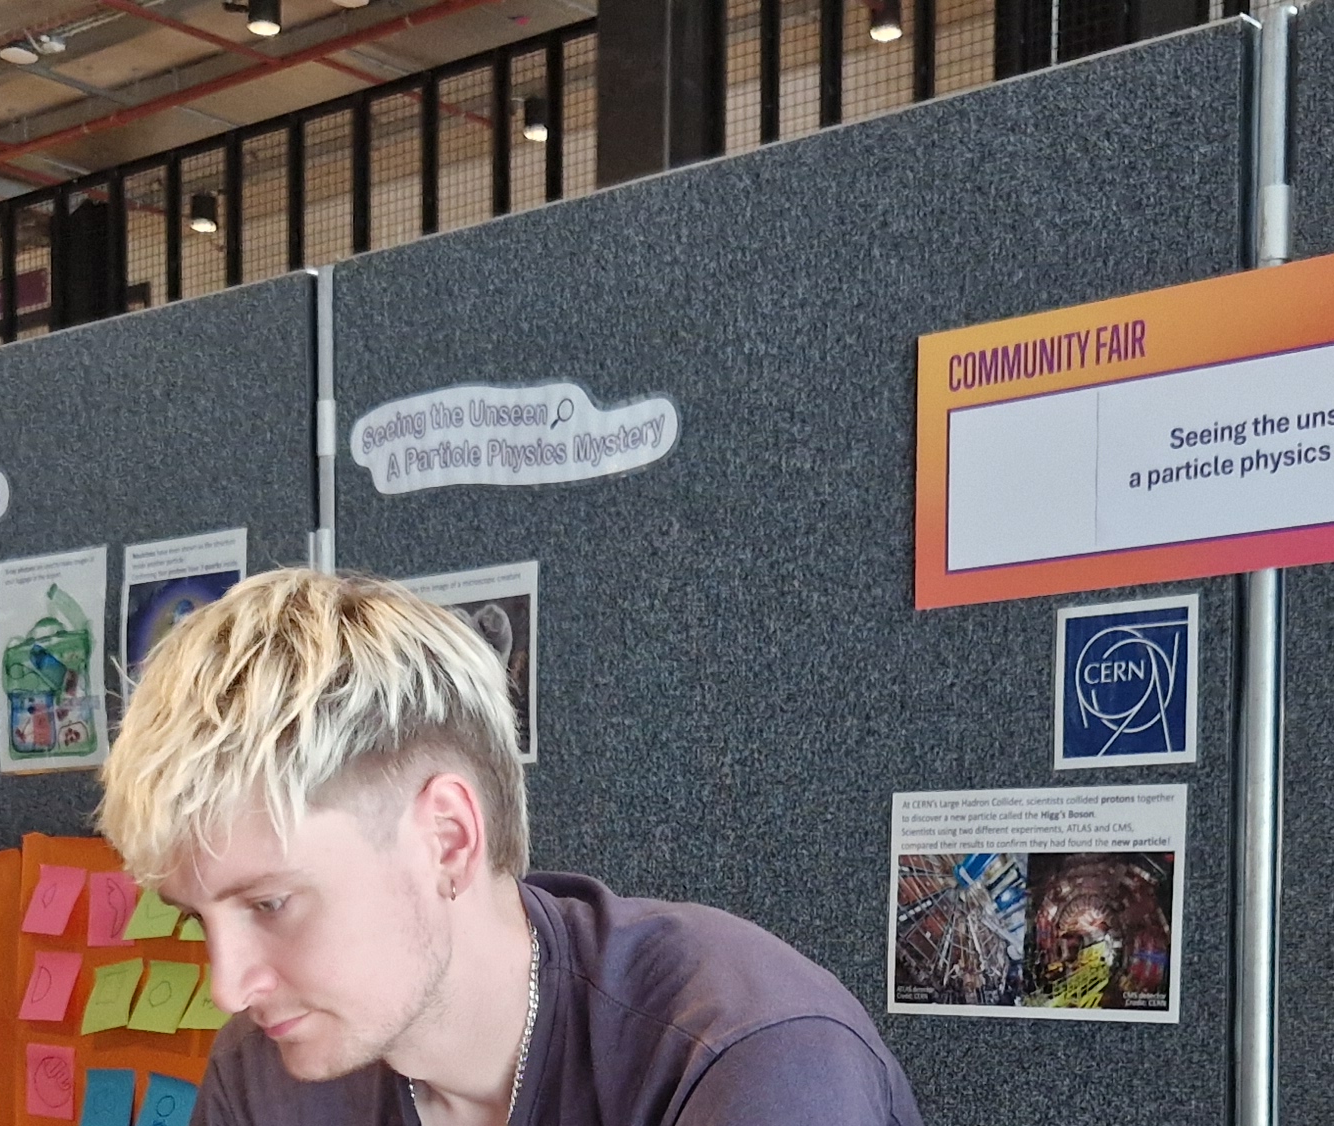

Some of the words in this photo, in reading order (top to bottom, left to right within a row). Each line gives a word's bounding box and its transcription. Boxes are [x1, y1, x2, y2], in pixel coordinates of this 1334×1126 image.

[948, 329, 1091, 393] COMMUNITY
[1095, 319, 1147, 366] FAIR
[362, 411, 427, 454] Seeing
[430, 403, 464, 430] the
[469, 399, 548, 428] Unseen
[1169, 420, 1248, 450] Seeing
[1252, 413, 1290, 437] the
[386, 453, 400, 481] A
[405, 441, 481, 476] Particle
[487, 439, 567, 473] Physics
[572, 414, 667, 467] Mystery
[1128, 471, 1141, 489] a
[1147, 454, 1234, 492] particle
[1239, 442, 1331, 478] physics
[1083, 660, 1145, 685] CERN
[901, 814, 910, 823] to
[911, 813, 942, 822] discover
[950, 813, 966, 821] new
[968, 811, 997, 822] particle
[999, 811, 1023, 820] called
[1024, 809, 1039, 820] the
[939, 800, 960, 810] Large
[961, 798, 990, 807] Hadron
[1066, 795, 1099, 805] collided
[1100, 795, 1135, 805] protons
[1137, 792, 1175, 805] together
[901, 827, 936, 837] Scientists
[937, 826, 957, 838] using
[959, 826, 973, 835] two
[974, 825, 1008, 835] different
[1067, 823, 1092, 833] ATLAS
[1094, 823, 1110, 832] and
[901, 841, 938, 851] compared
[940, 840, 957, 849] their
[959, 840, 984, 849] results
[986, 840, 995, 848] to
[996, 839, 1027, 848] confirm
[1029, 839, 1047, 850] they
[1050, 838, 1066, 848] had
[1067, 838, 1093, 848] found
[1094, 837, 1109, 847] the
[1111, 838, 1131, 847] new
